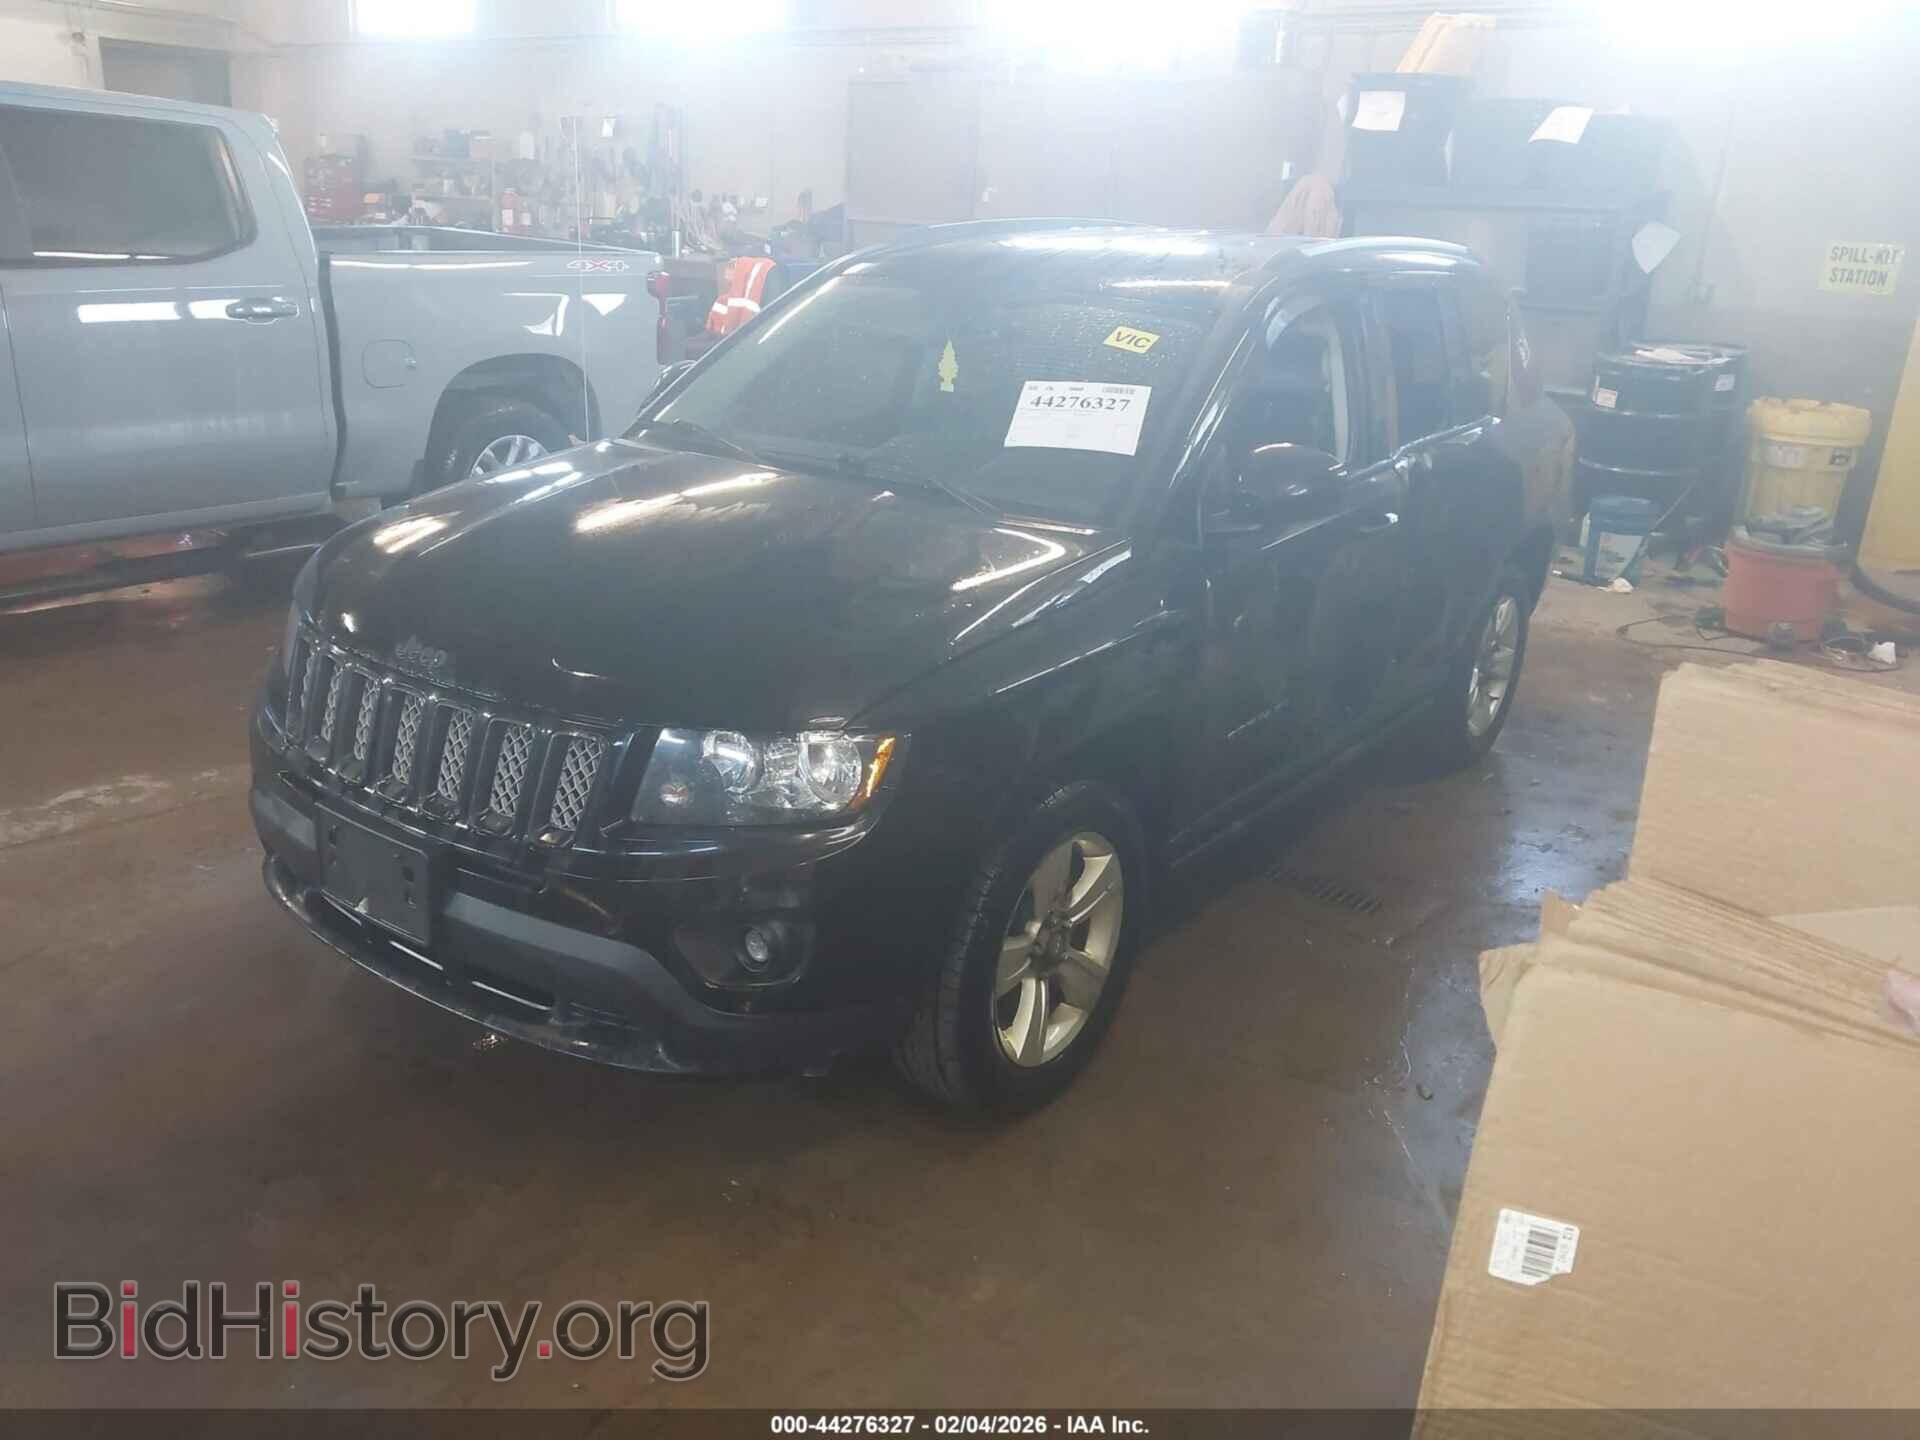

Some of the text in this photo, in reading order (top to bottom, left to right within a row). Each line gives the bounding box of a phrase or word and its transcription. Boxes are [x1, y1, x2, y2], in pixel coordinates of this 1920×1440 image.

[1829, 245, 1899, 265] SPILL-KIT
[1829, 267, 1889, 287] STATION
[1114, 330, 1151, 349] VIC
[1029, 395, 1131, 412] 44276327
